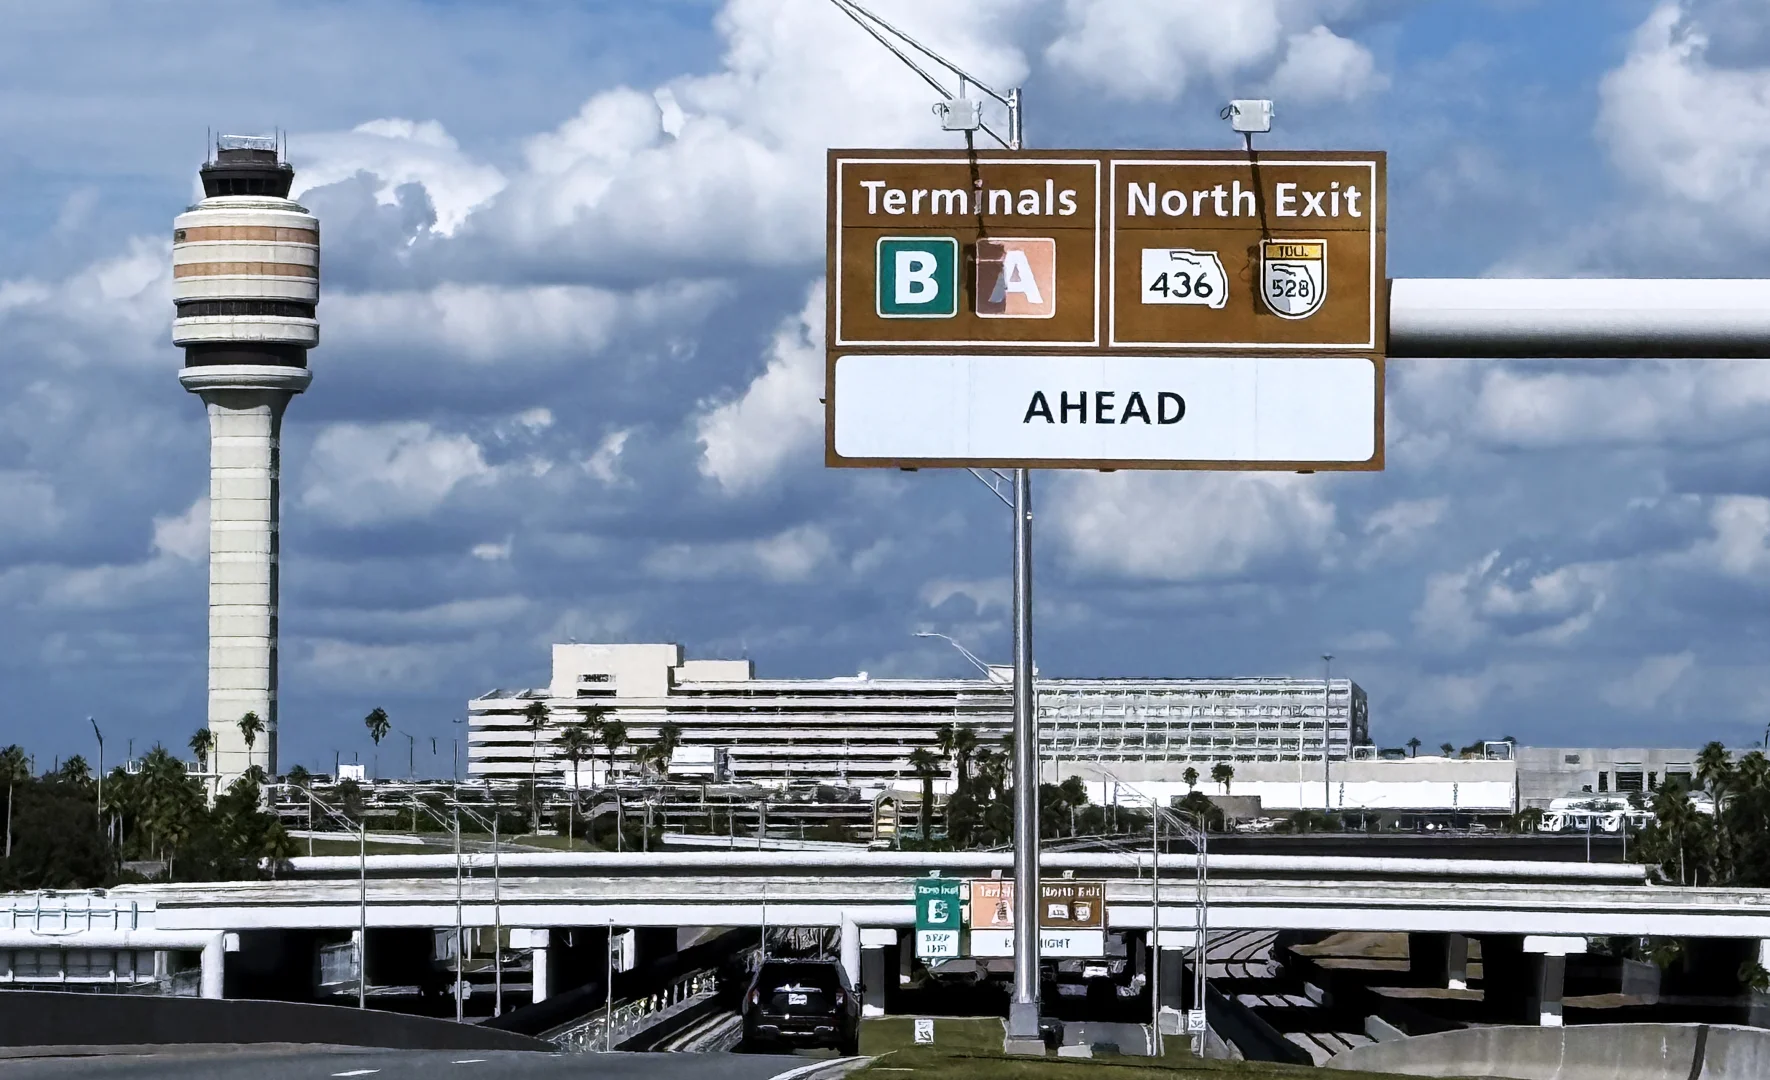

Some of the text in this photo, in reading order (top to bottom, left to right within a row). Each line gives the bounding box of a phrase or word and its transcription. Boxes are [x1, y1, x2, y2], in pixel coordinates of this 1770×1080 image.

[860, 178, 1078, 217] Terminals
[1127, 181, 1362, 218] North Exit
[894, 250, 1044, 304] B A
[1148, 270, 1214, 299] 436
[1272, 279, 1309, 298] 528
[1023, 390, 1186, 425] AHEAD
